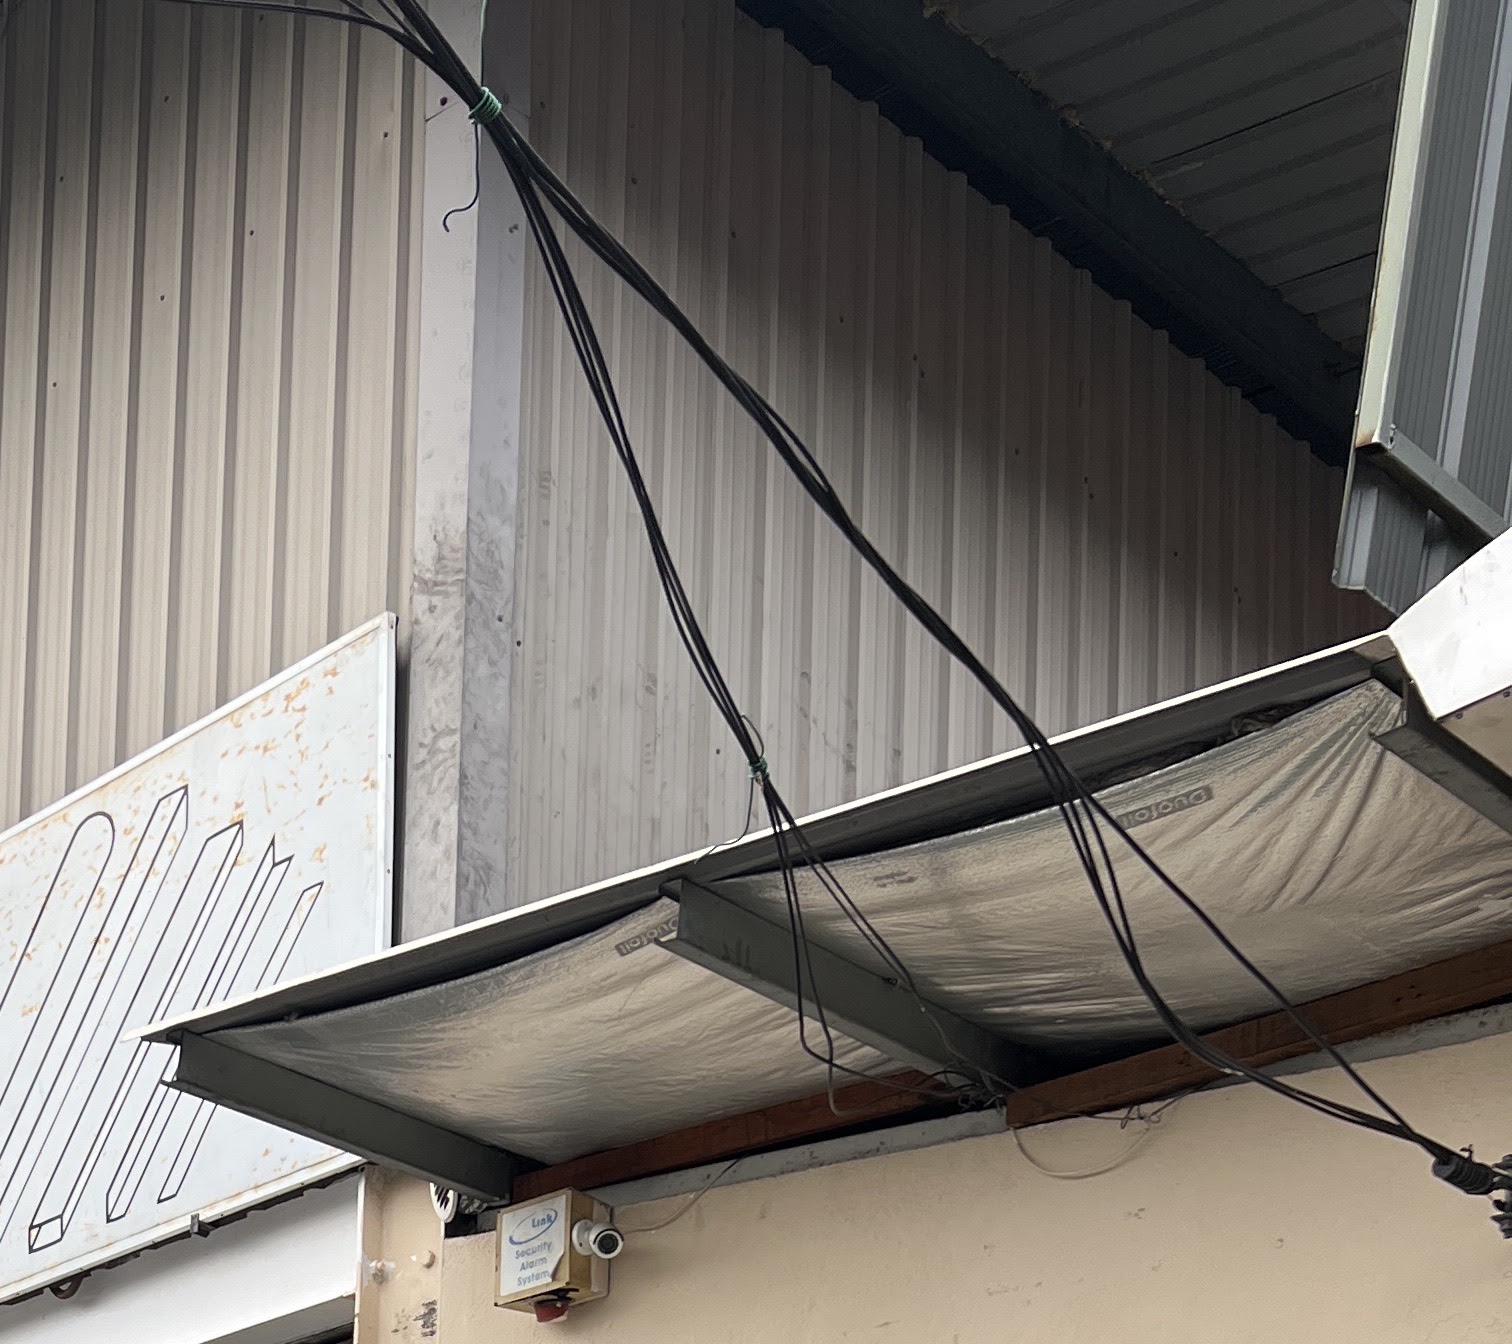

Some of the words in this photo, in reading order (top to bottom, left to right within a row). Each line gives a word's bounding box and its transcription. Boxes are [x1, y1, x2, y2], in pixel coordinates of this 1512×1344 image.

[515, 1241, 553, 1260] Security
[519, 1256, 548, 1272] Alarm
[517, 1270, 550, 1286] System
